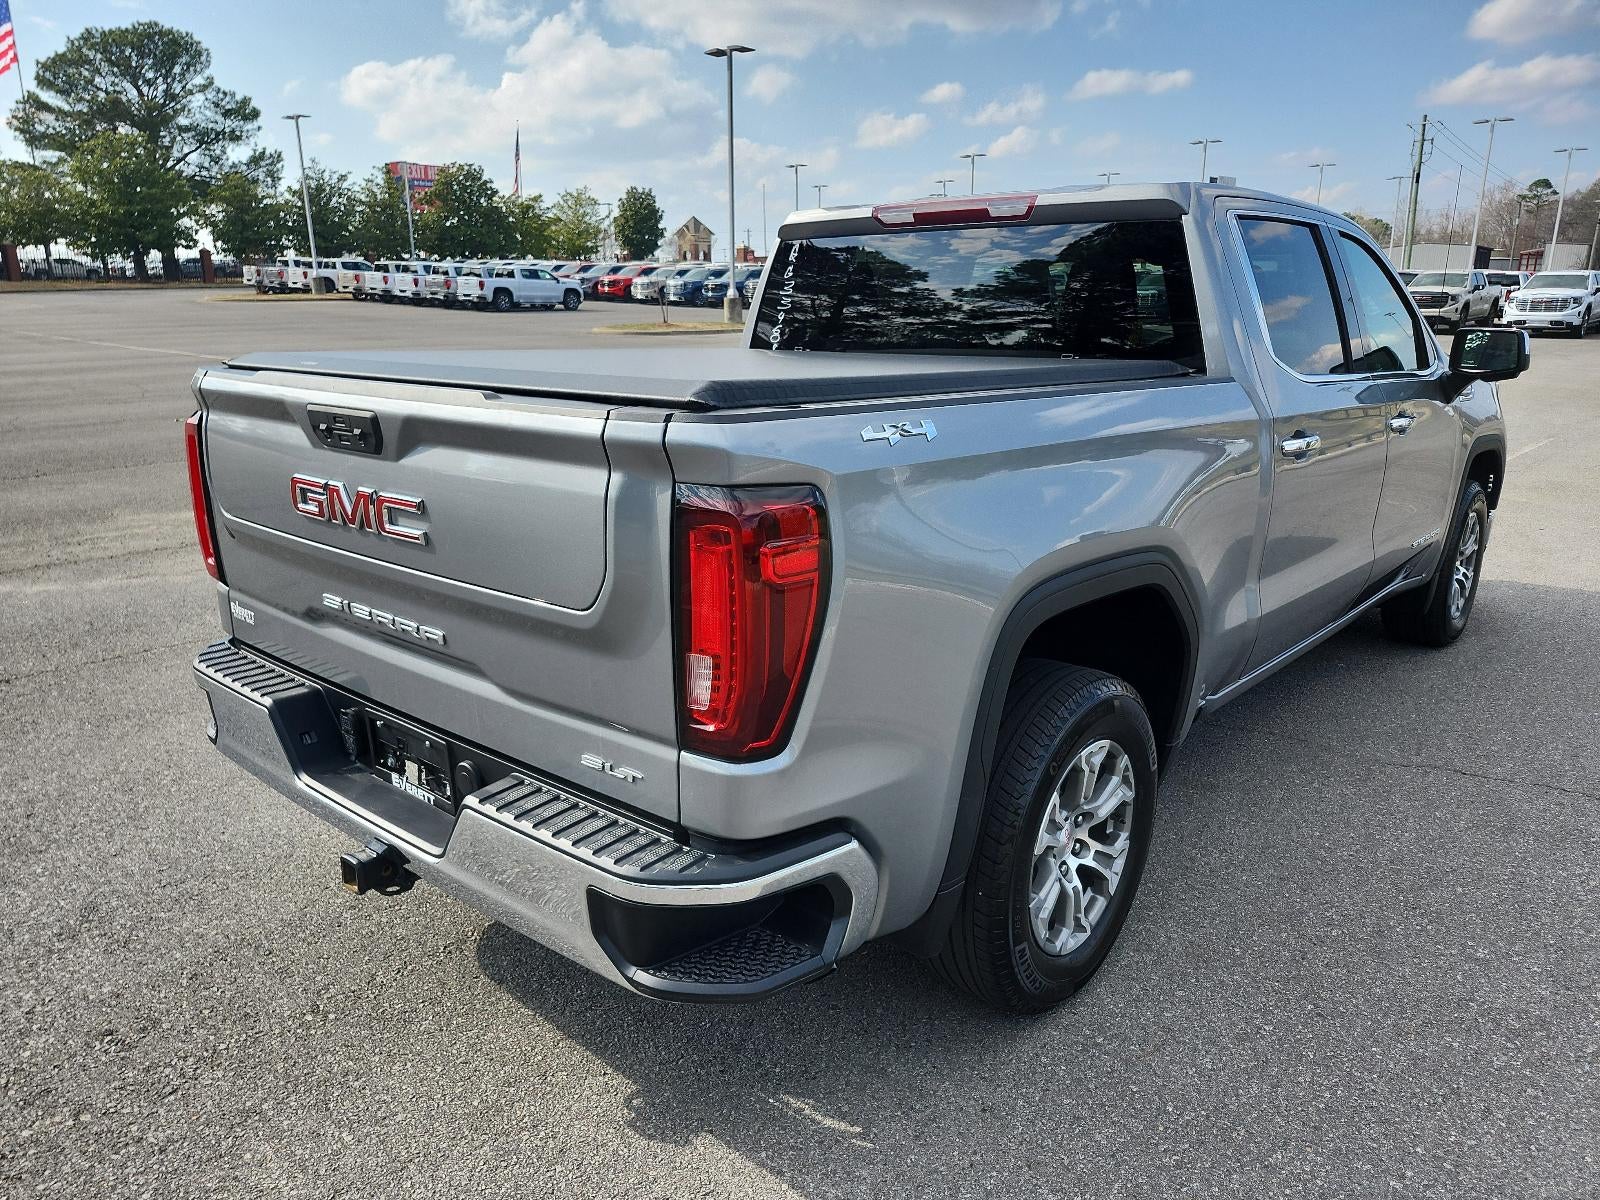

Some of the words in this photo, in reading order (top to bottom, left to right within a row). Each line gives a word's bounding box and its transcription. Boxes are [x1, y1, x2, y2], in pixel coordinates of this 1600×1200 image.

[289, 472, 430, 547] GMC
[322, 593, 447, 645] SIERRA
[580, 752, 644, 783] SLT
